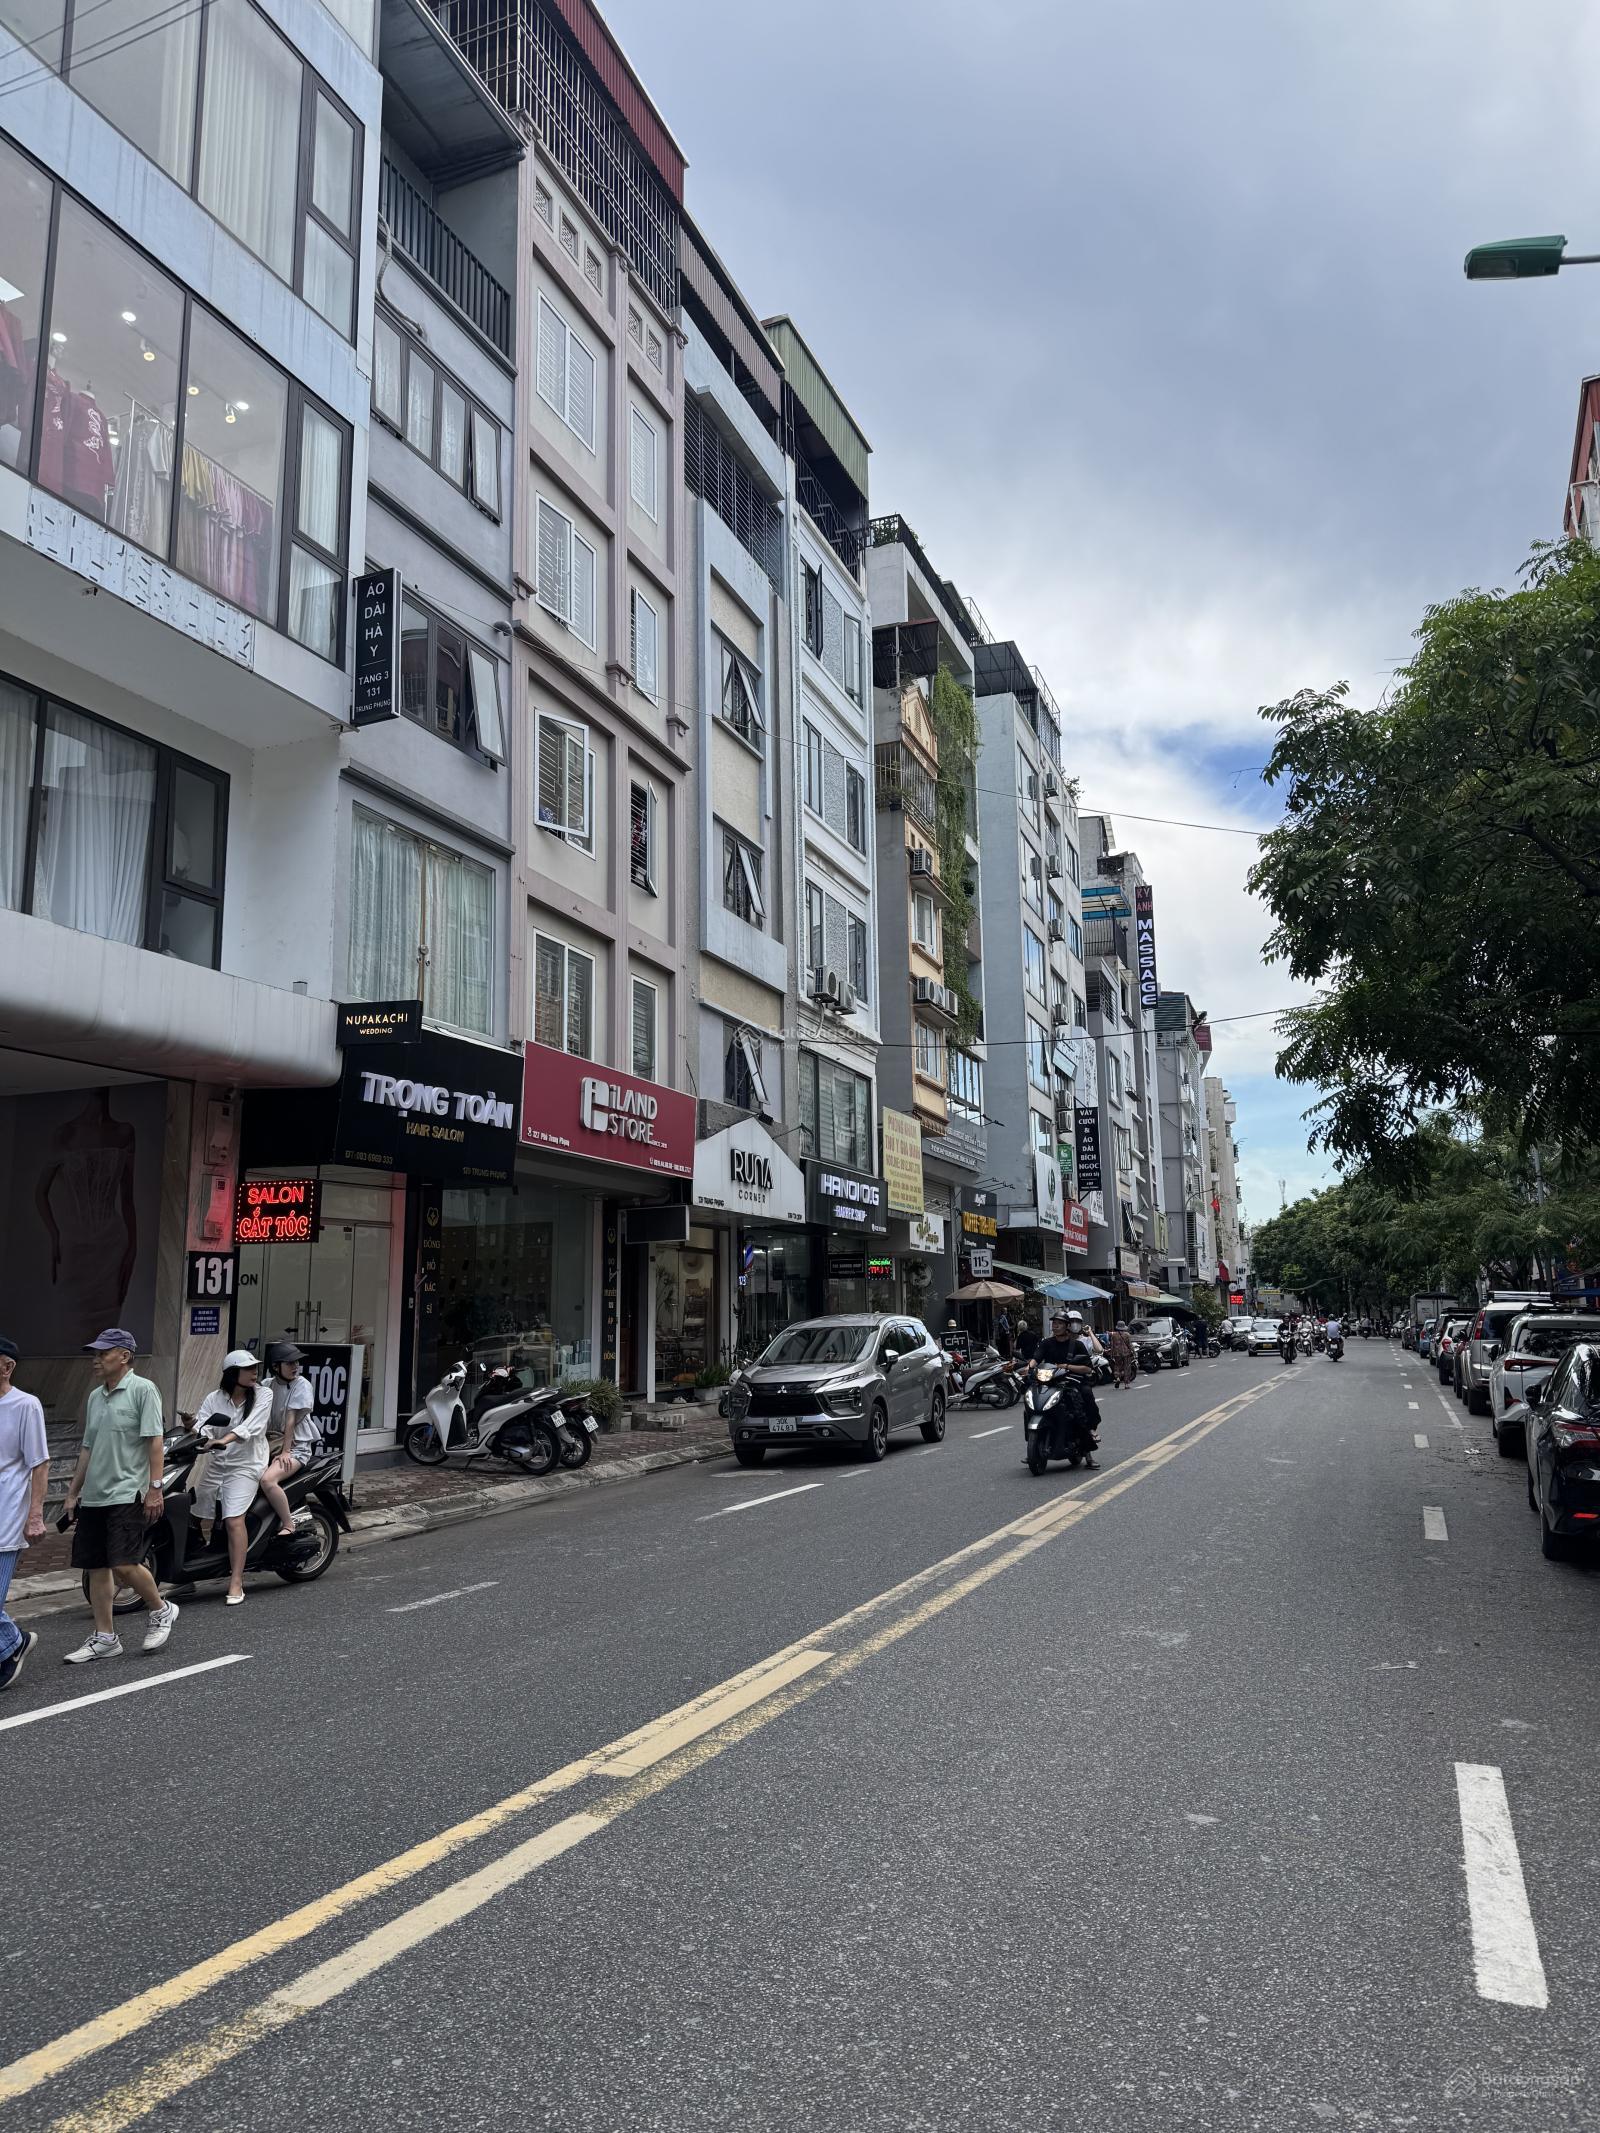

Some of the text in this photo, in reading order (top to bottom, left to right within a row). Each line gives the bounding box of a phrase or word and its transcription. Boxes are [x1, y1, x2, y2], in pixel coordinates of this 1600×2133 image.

[370, 645, 379, 657] Y
[384, 671, 389, 680] 3
[366, 686, 381, 698] 131
[1138, 919, 1157, 1005] MASSAGE
[346, 1013, 408, 1025] NUPAKACHI
[359, 1027, 393, 1035] WEDDING
[361, 1071, 514, 1130] TRỌNG TOÀN
[405, 1121, 465, 1143] HAIR SALON
[608, 1113, 655, 1145] STORE
[247, 1185, 305, 1205] SALON
[739, 1190, 766, 1204] CORNER
[820, 1173, 860, 1202] HANOI
[239, 1207, 309, 1238] CẮT TÓC
[973, 1255, 989, 1267] 115
[195, 1257, 234, 1295] 131
[308, 1357, 347, 1406] TÓC
